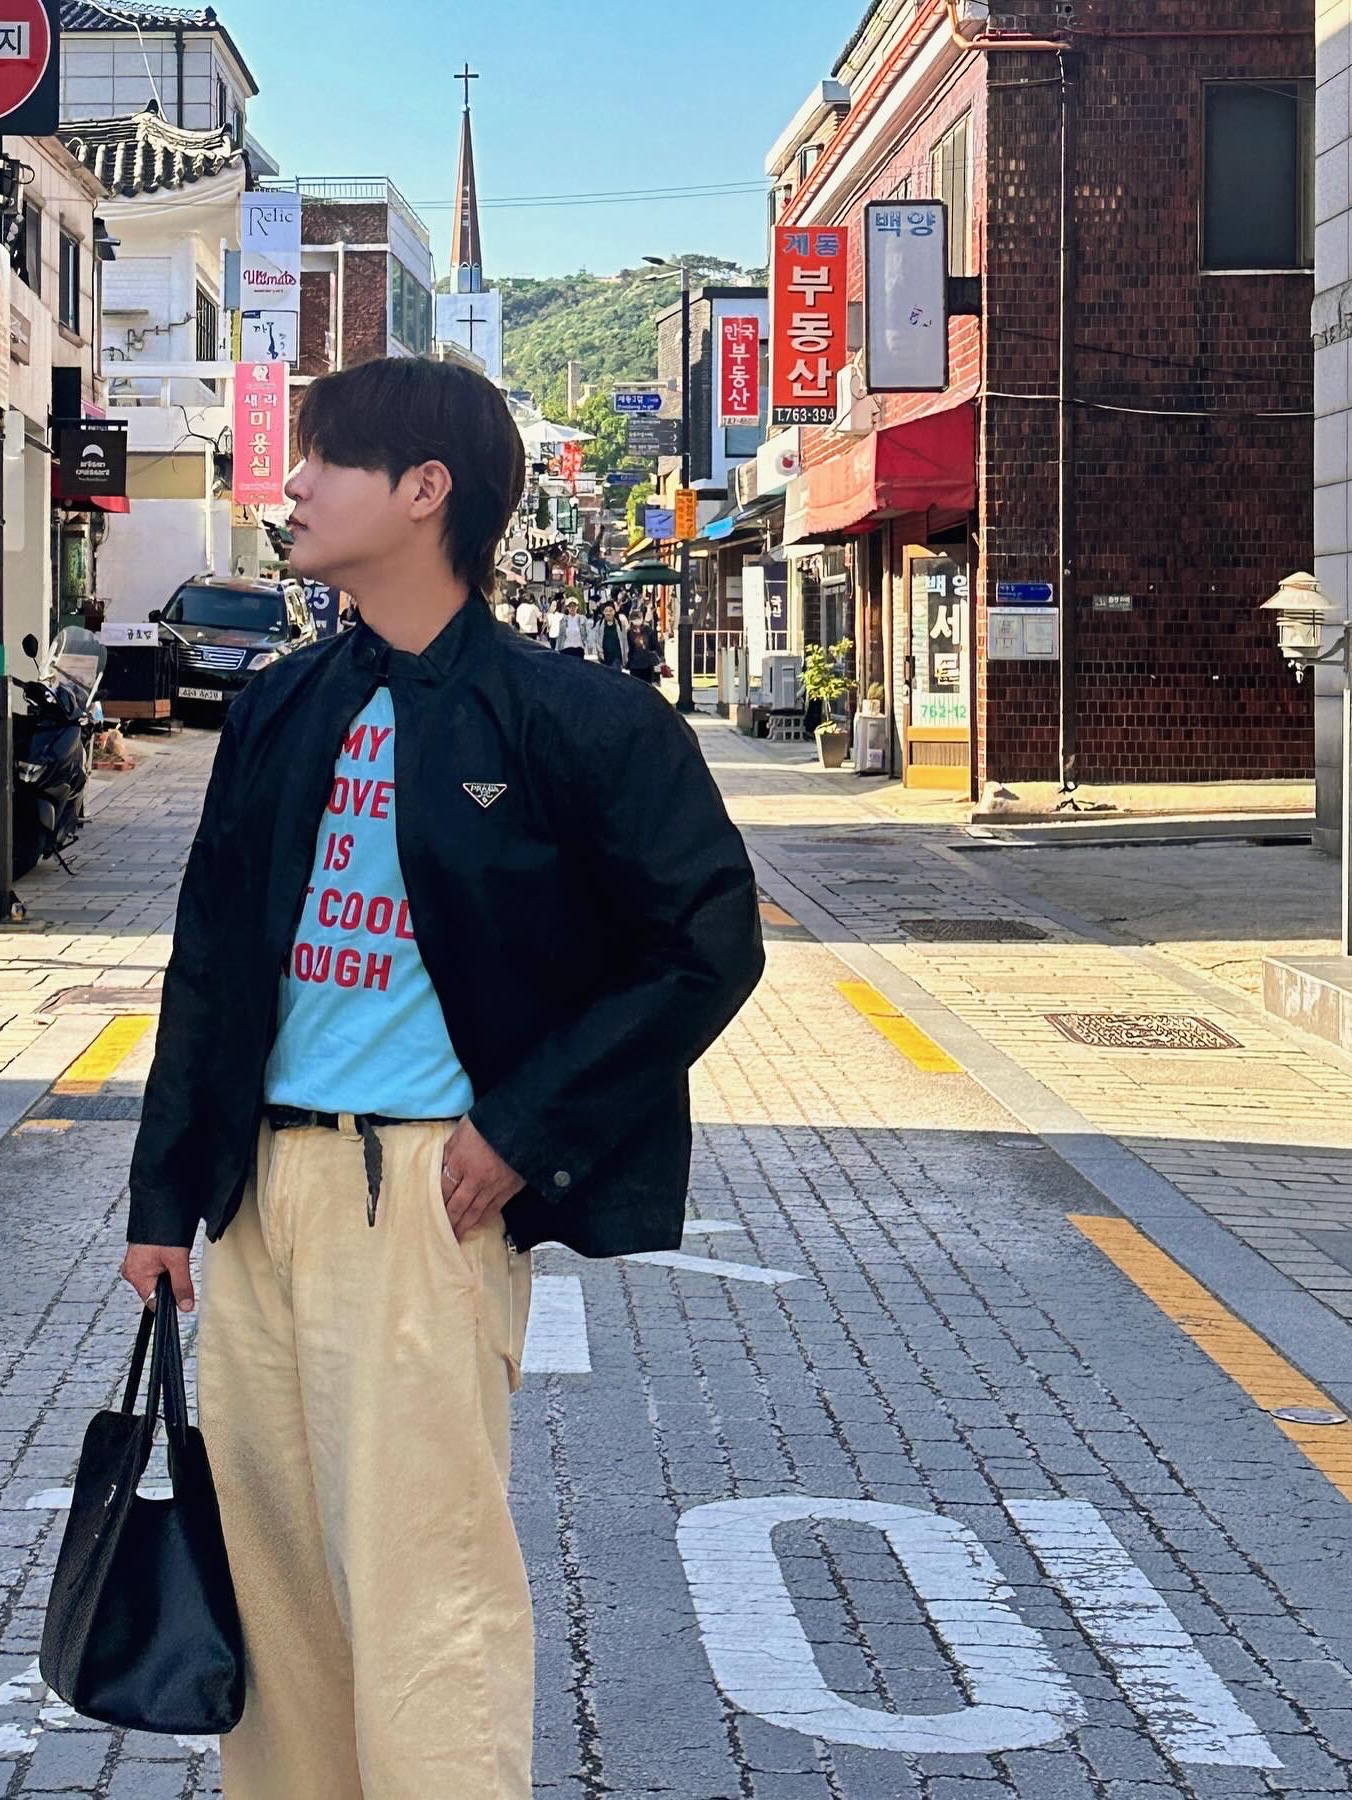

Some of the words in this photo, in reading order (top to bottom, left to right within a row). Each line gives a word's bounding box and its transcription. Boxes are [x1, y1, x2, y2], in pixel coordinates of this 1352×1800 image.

[0, 25, 22, 56] 지
[249, 207, 294, 236] Relic
[724, 323, 756, 341] 만국
[787, 266, 833, 397] 부동산
[728, 343, 750, 411] 부동산
[248, 410, 272, 477] 미용실
[335, 724, 393, 762] MY
[323, 832, 354, 872] IS
[318, 887, 415, 940] COOL
